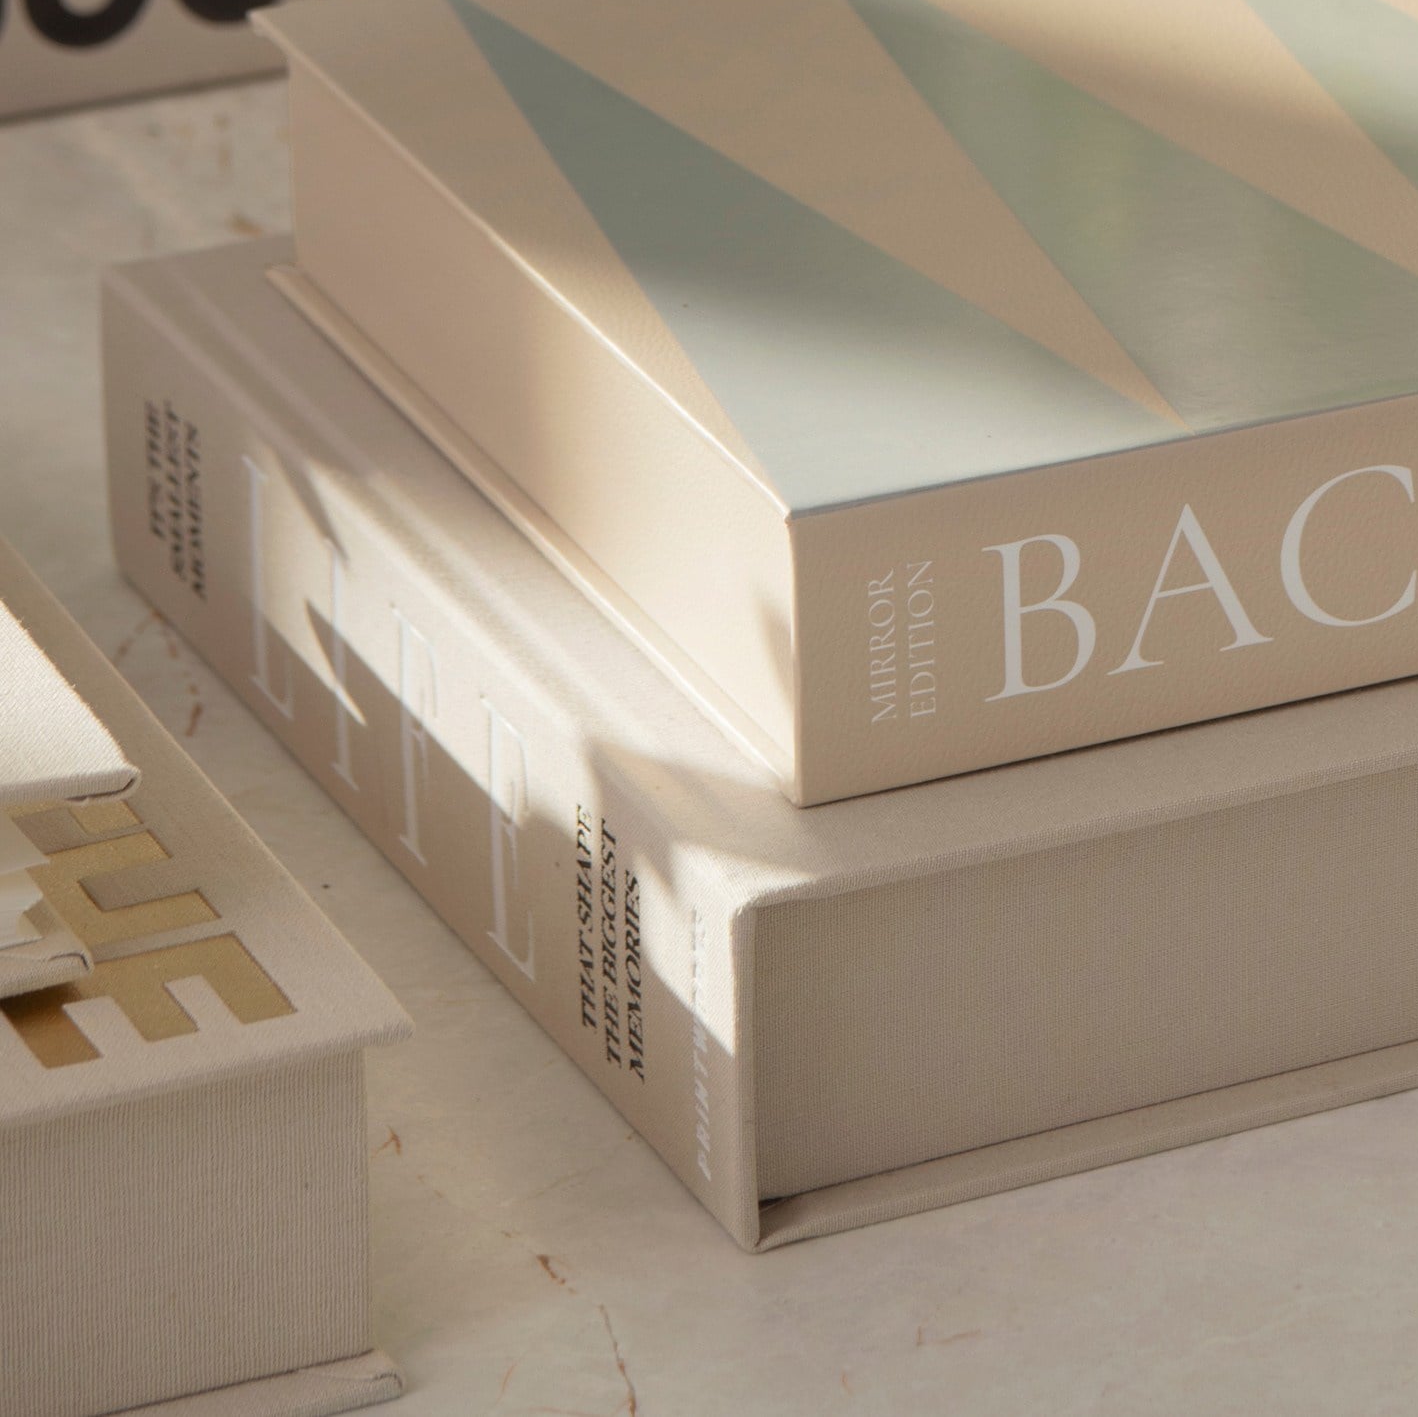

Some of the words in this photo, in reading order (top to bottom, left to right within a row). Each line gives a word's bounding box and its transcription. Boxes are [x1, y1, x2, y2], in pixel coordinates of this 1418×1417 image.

[240, 452, 537, 984] LIFE
[867, 567, 897, 724] MIRROR
[906, 560, 936, 719] EDITION
[576, 804, 594, 933] SHAPE
[600, 817, 618, 988] BIGGEST
[579, 929, 598, 1033] THAT
[603, 984, 622, 1069] THE
[624, 868, 645, 1084] MEMORIES
